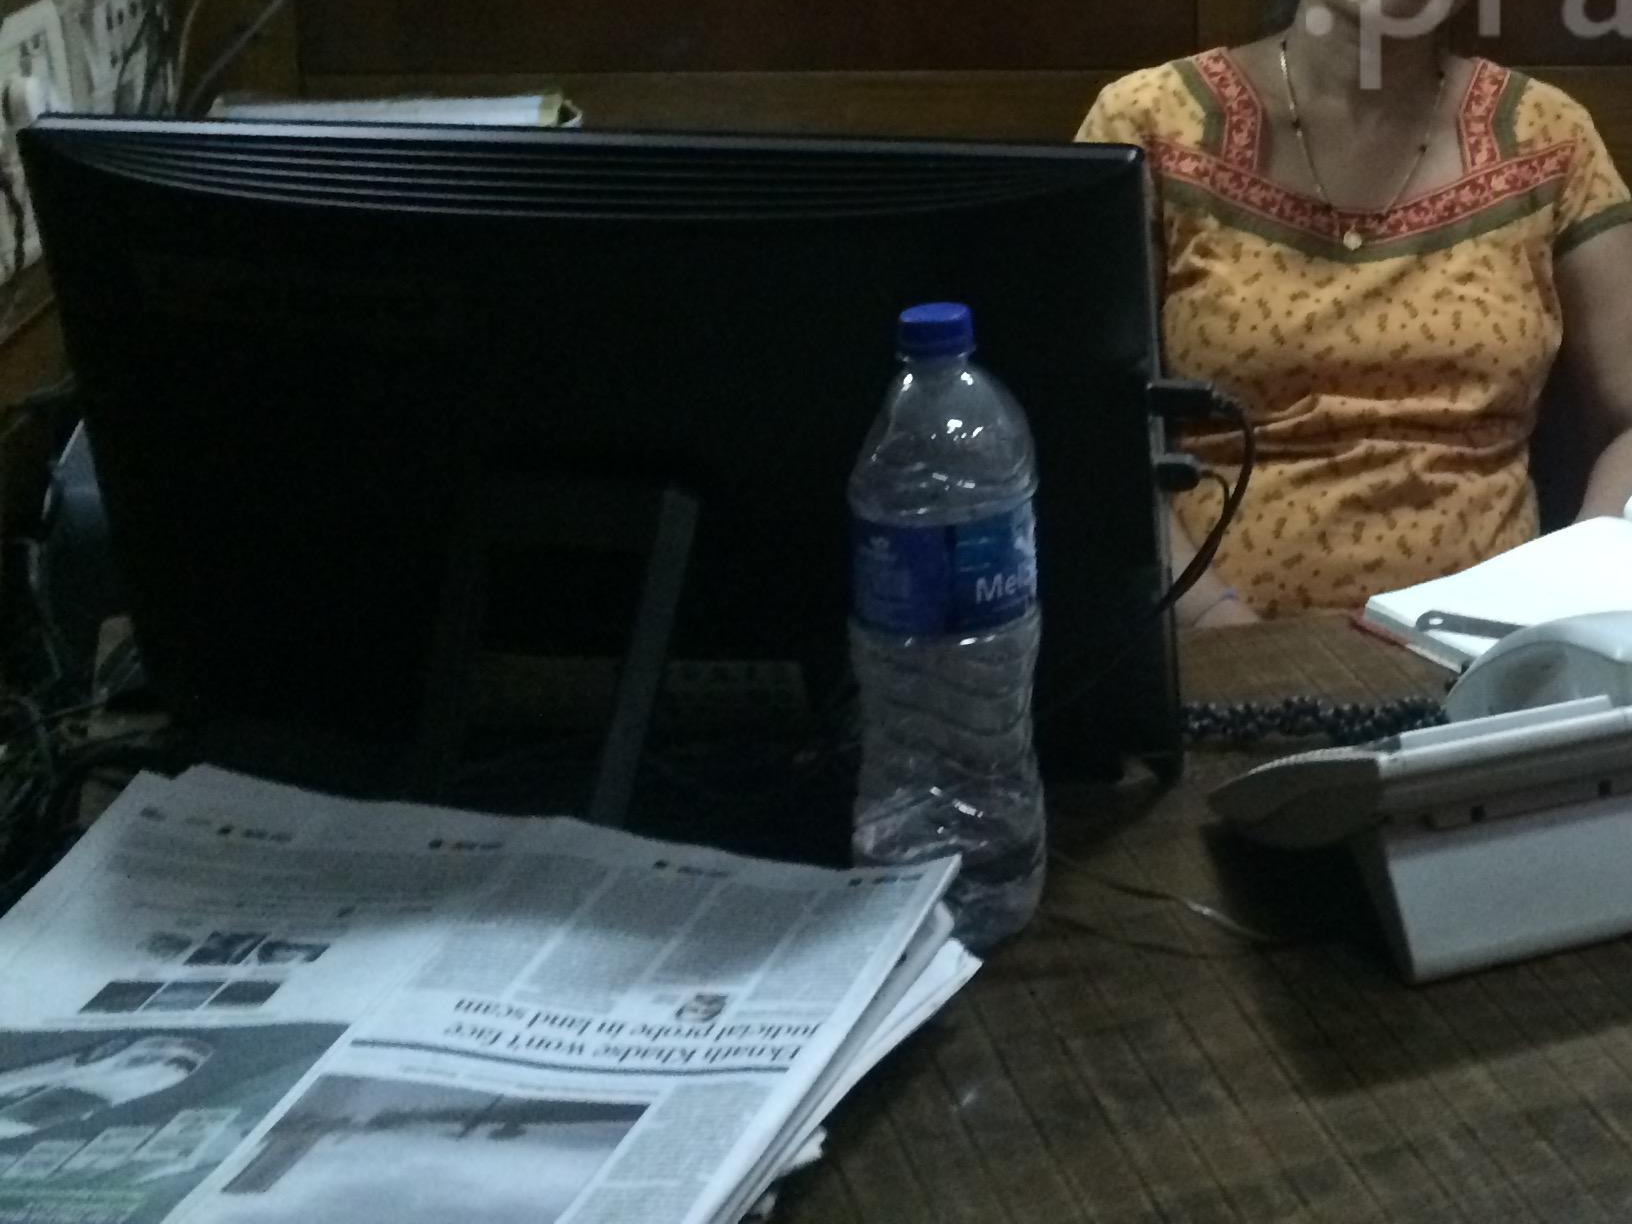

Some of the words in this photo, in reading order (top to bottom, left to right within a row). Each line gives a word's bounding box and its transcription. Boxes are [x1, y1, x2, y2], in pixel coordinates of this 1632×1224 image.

[453, 998, 527, 1020] scam
[526, 1010, 593, 1036] land
[596, 1020, 626, 1038] in
[630, 1023, 716, 1043] probe
[714, 1022, 822, 1042] judicial
[442, 1022, 503, 1047] face
[506, 1033, 585, 1057] won't
